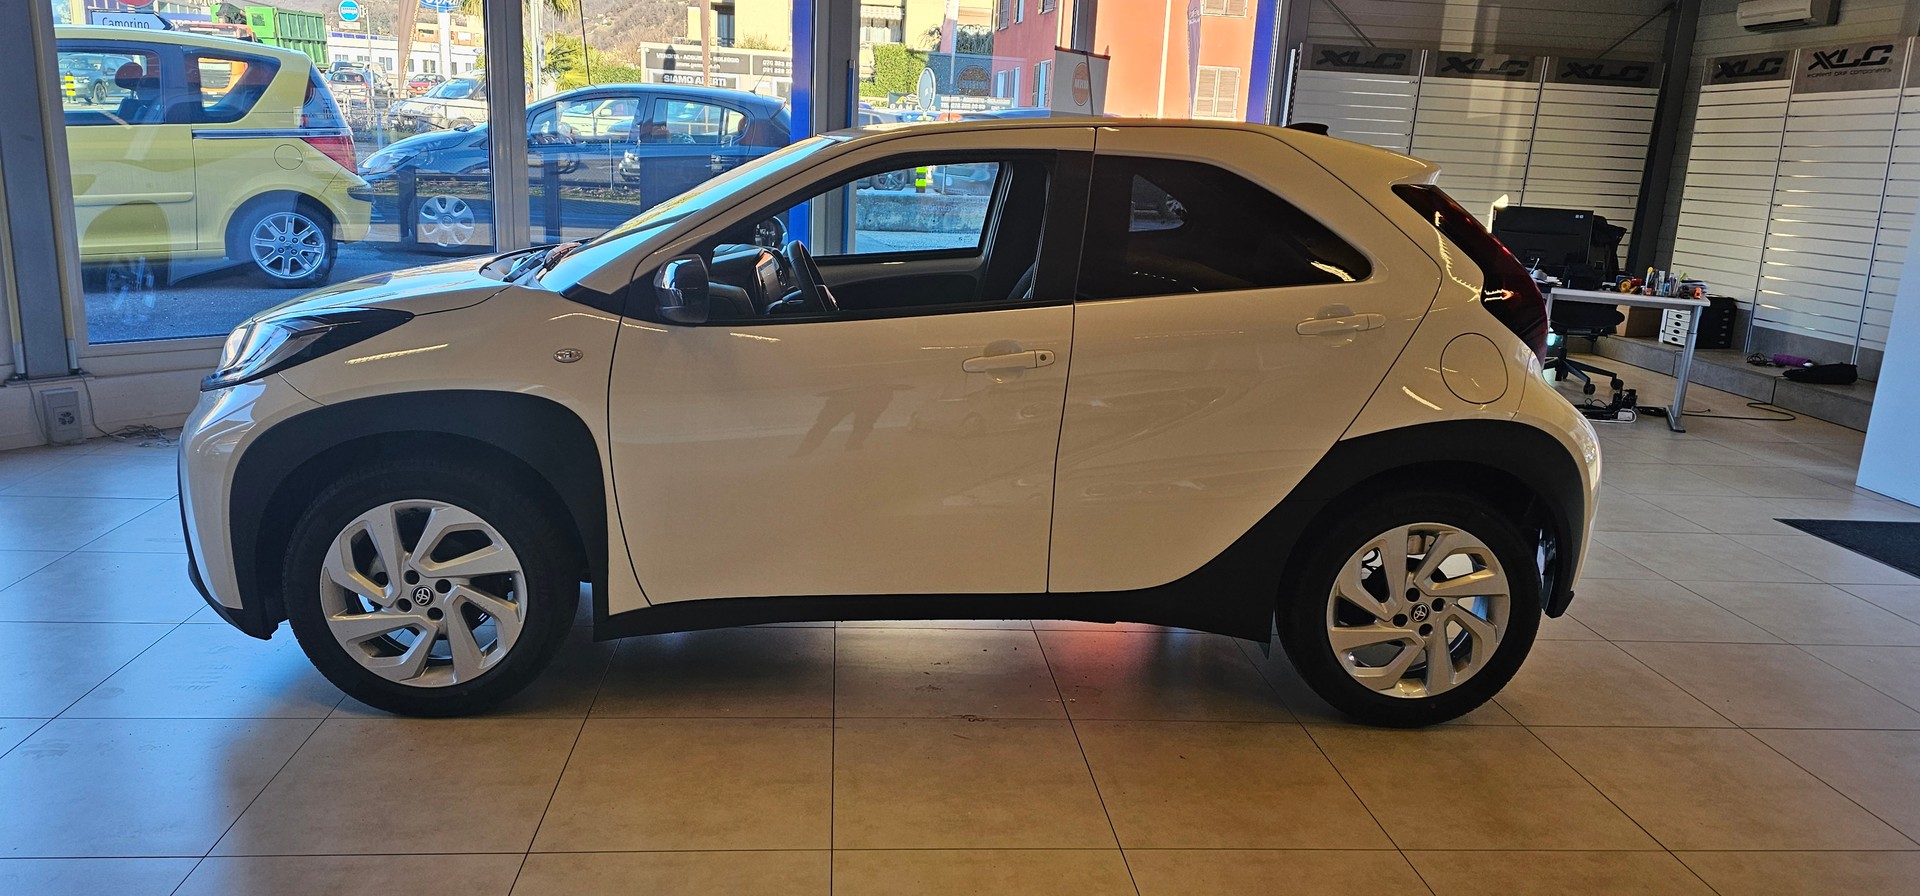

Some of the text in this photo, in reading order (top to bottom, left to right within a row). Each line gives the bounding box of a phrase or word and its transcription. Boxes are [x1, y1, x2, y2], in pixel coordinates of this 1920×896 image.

[102, 17, 150, 29] Camorino
[1316, 50, 1406, 69] XLC
[1441, 57, 1529, 76] XLC
[1808, 44, 1894, 71] XLC
[1561, 62, 1649, 82] XLC
[1714, 57, 1784, 79] XLC
[664, 75, 694, 84] SIAMO
